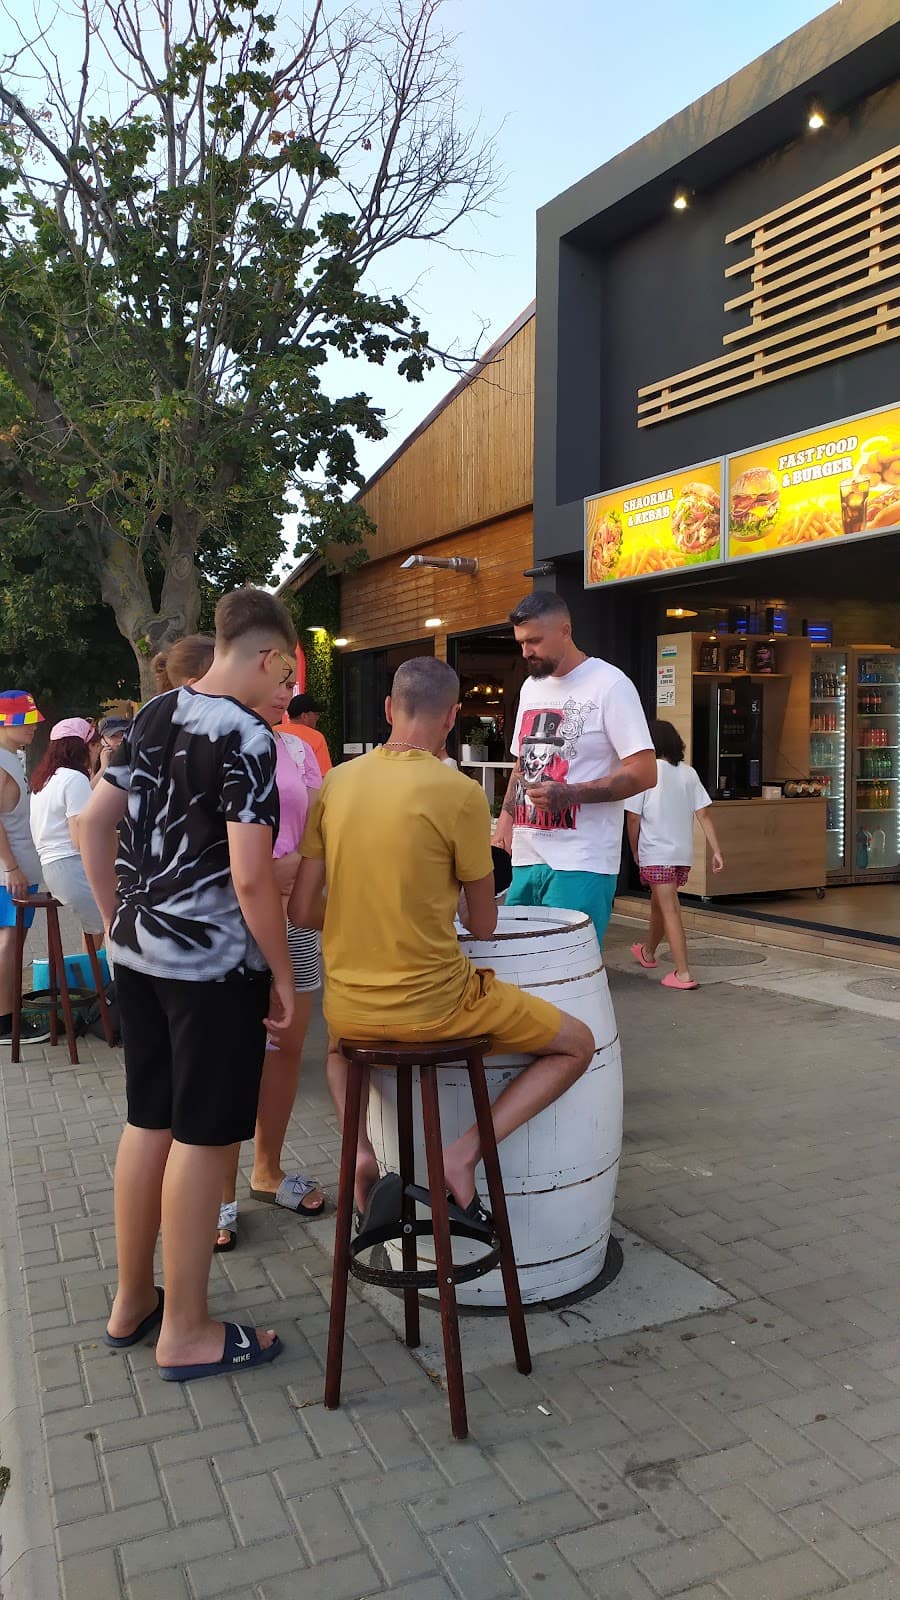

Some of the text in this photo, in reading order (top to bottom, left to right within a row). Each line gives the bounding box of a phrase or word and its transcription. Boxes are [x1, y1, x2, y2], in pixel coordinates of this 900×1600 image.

[778, 435, 858, 471] FAST FOOD
[782, 456, 853, 488] & BURGER
[623, 488, 674, 513] SHAORMA
[628, 505, 670, 527] & KEBAB
[232, 1353, 251, 1364] NIKE
